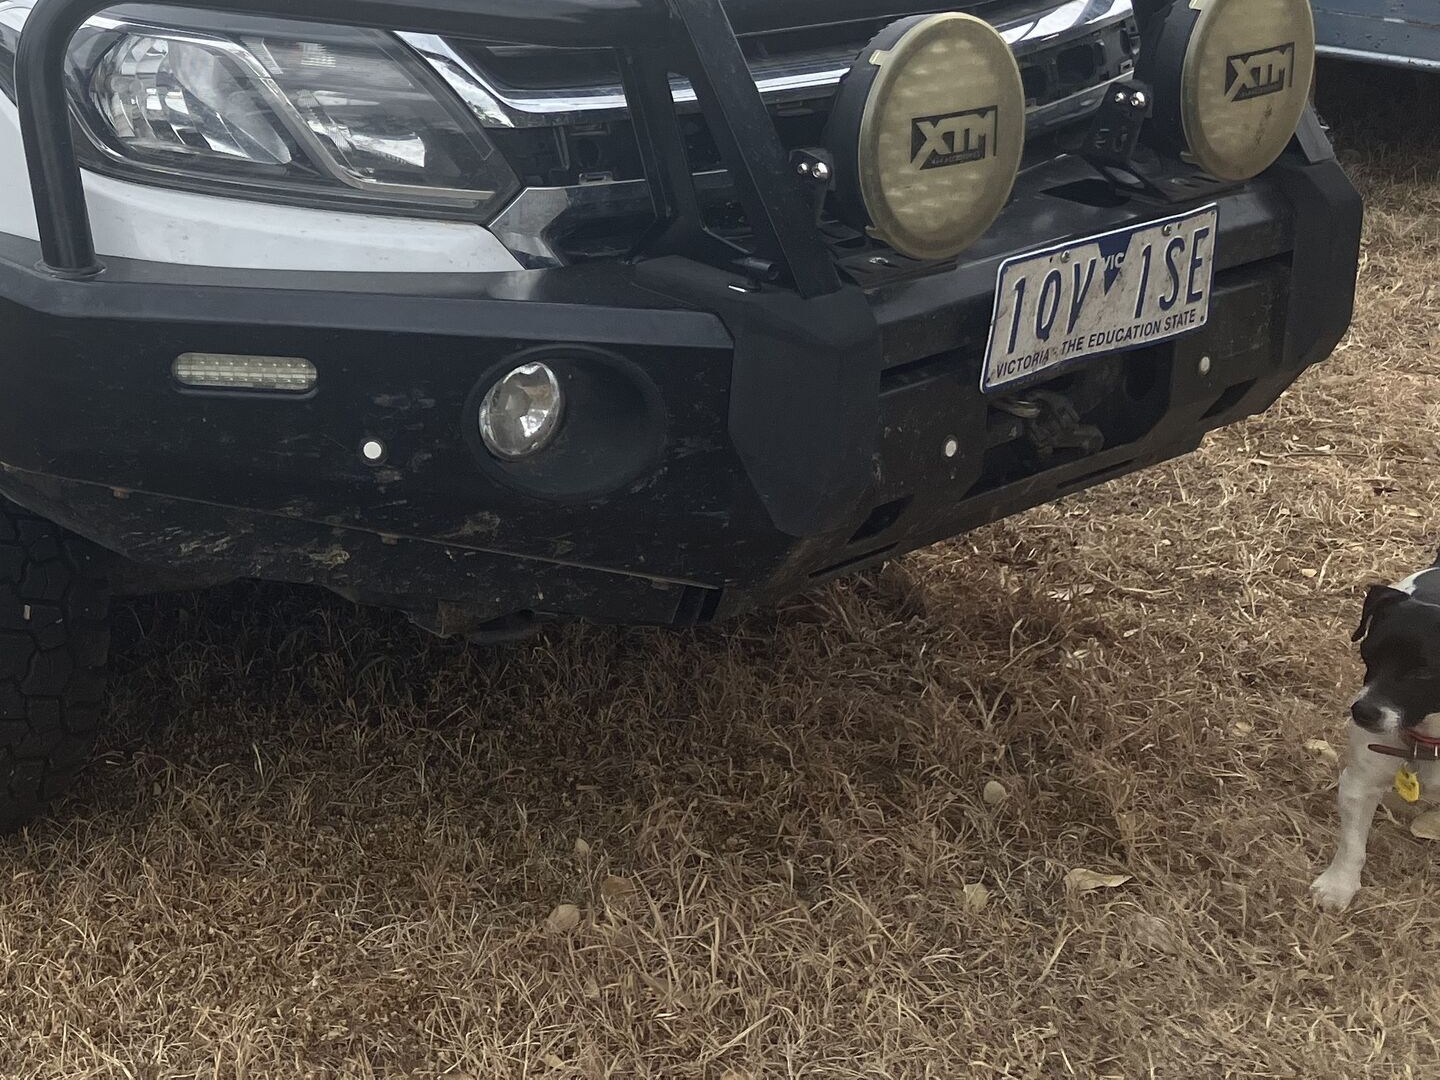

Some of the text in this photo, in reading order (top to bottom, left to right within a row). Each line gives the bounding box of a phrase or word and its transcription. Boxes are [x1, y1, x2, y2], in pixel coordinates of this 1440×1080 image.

[1224, 42, 1294, 102] XTM
[911, 106, 997, 169] XTM
[1006, 226, 1210, 355] 1QV 1SE
[1101, 252, 1125, 271] VIC
[996, 349, 1050, 378] VICTORIA
[1061, 336, 1085, 355] THE
[1088, 320, 1162, 349] EDUCATION
[1164, 308, 1196, 331] STATE
